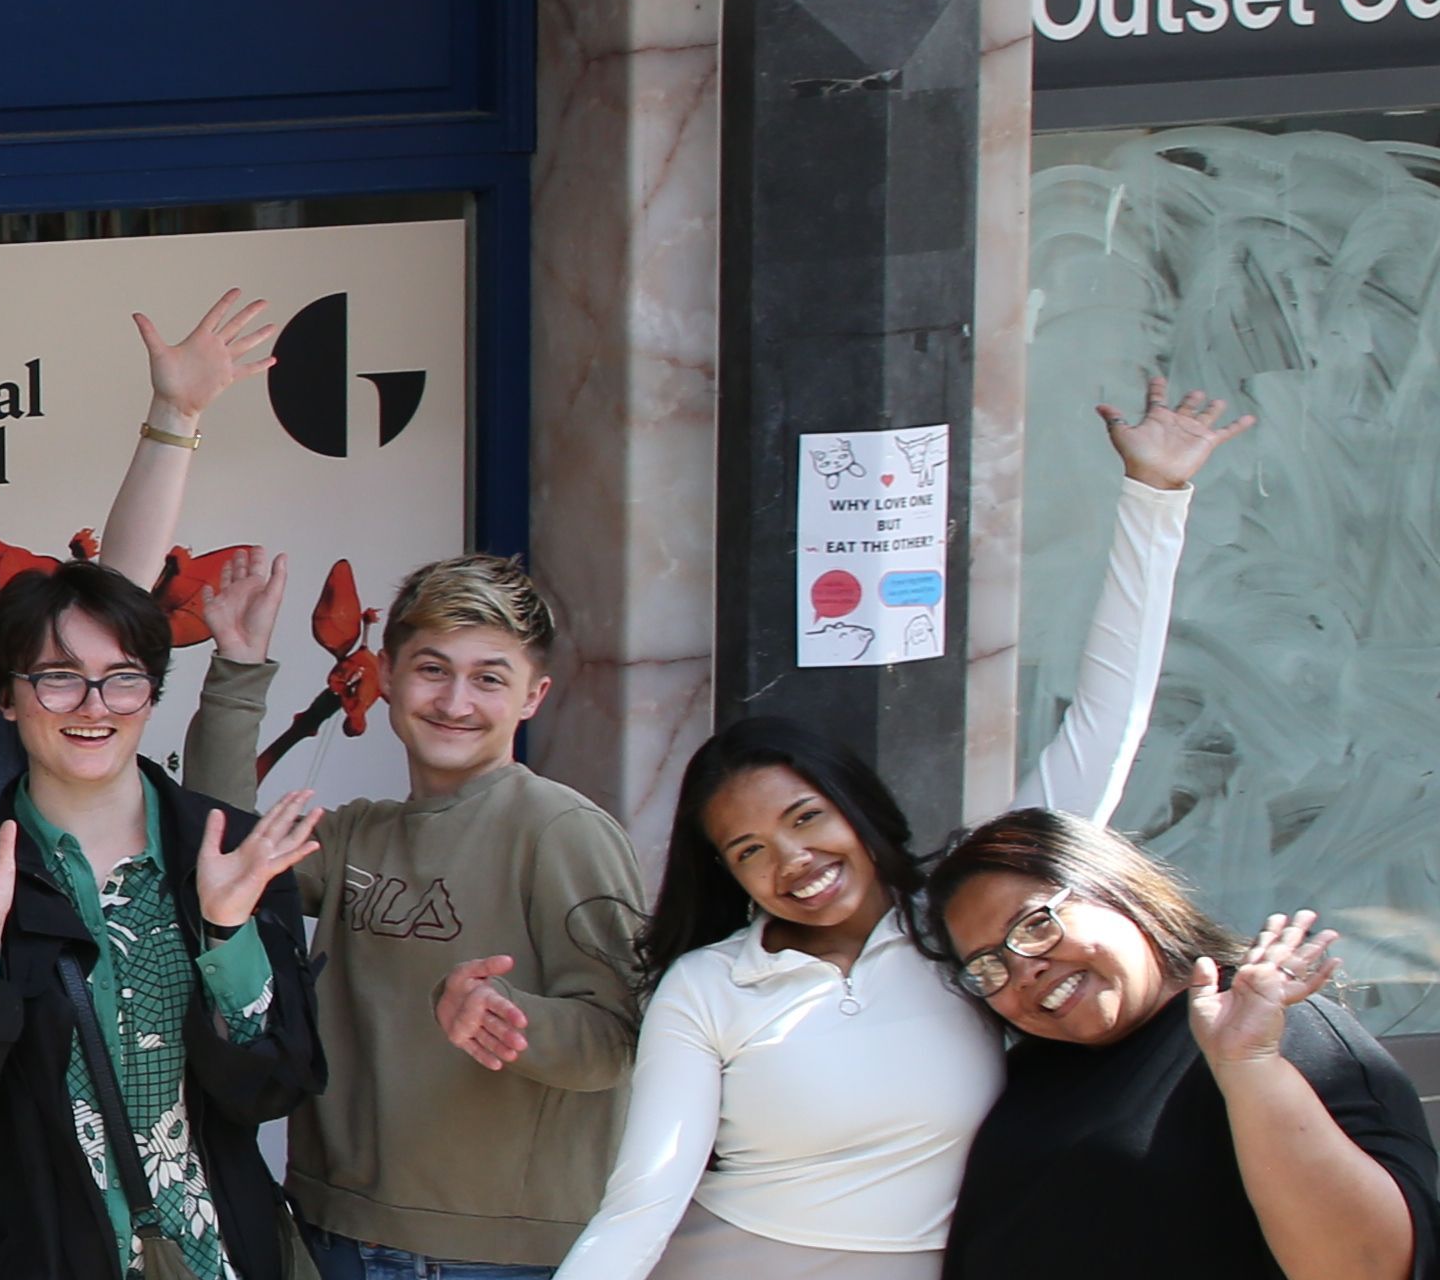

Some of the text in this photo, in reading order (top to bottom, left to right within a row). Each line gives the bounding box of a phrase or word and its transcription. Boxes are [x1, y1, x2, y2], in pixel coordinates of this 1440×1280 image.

[830, 494, 933, 511] WHY LOVE ONE
[877, 518, 902, 531] BUT
[826, 535, 934, 553] EAT THE OTHER?
